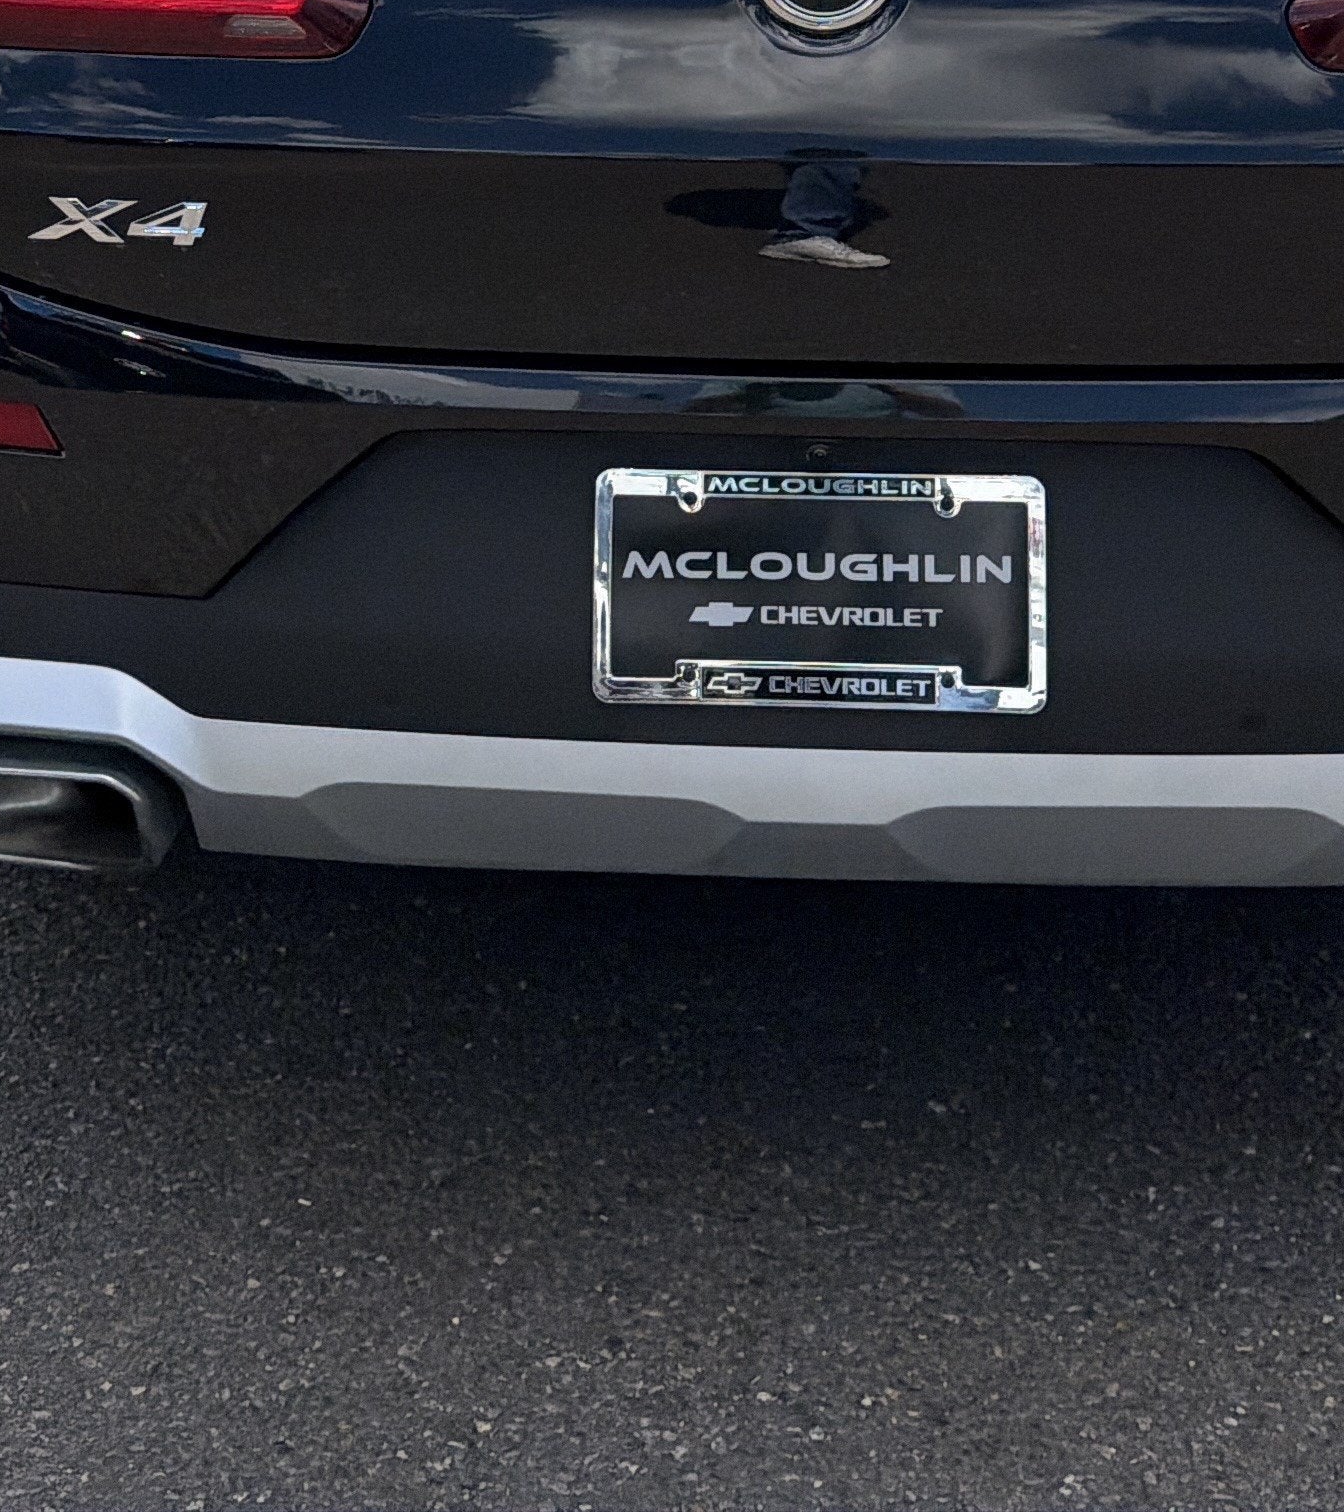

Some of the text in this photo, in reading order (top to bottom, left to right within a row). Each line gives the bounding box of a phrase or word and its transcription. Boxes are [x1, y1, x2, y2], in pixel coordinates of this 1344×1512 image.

[27, 196, 208, 246] X4
[707, 476, 932, 495] MCLOUGHLIN
[622, 550, 1012, 583] MCLOUGHLIN
[760, 605, 943, 628] CHEVROLET
[769, 675, 931, 697] CHEVROLET
